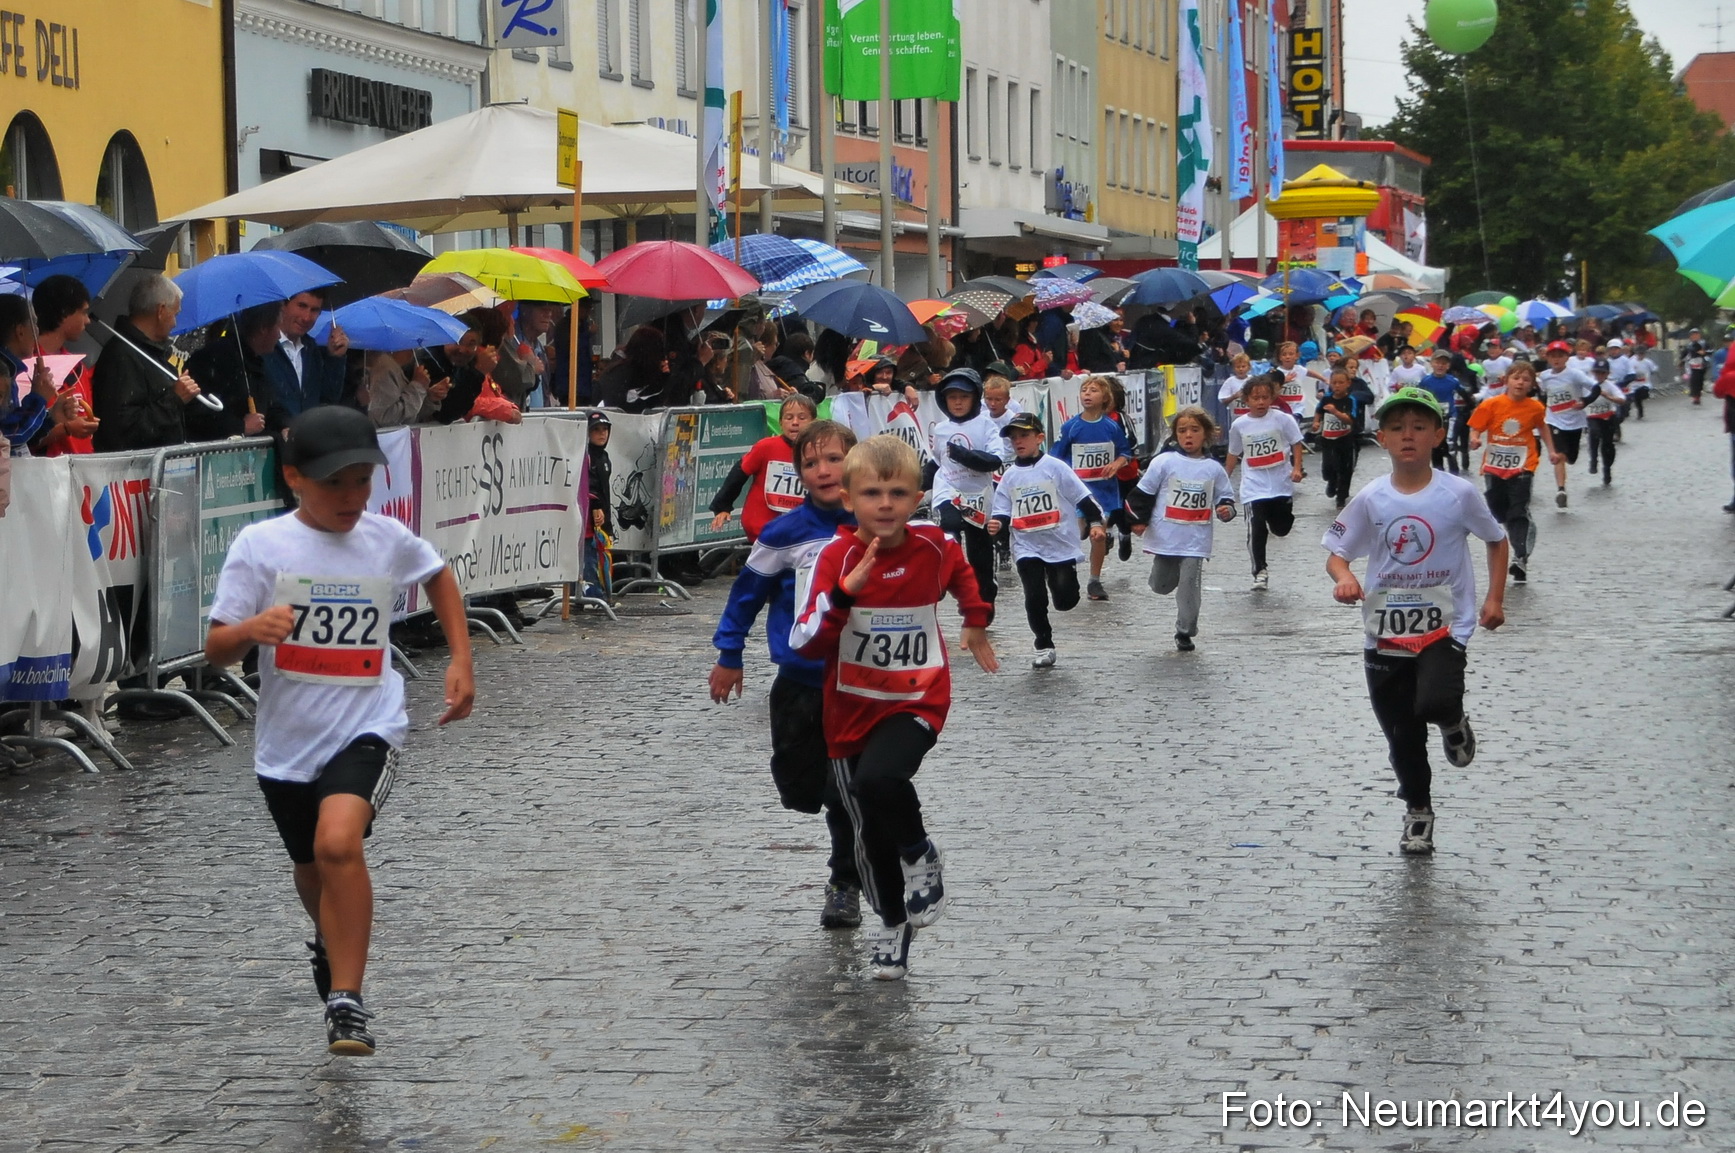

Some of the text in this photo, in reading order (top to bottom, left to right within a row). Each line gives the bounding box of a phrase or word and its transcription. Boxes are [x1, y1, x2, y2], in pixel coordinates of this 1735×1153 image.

[850, 31, 944, 43] Verantortung leben.
[0, 10, 79, 90] FE DELI
[862, 45, 933, 55] Gens schaffen.
[320, 69, 432, 133] BRILLEN WEBER
[1247, 439, 1278, 457] 7252
[1077, 452, 1110, 468] 7068
[1490, 453, 1520, 468] 7259
[436, 464, 477, 501] RECHTS
[510, 452, 571, 488] ANWÄLTE
[1016, 493, 1053, 518] 7120
[1172, 490, 1207, 508] 7298
[1376, 572, 1403, 580] AUFEN
[311, 584, 360, 596] BOCK
[289, 604, 379, 645] 7322
[871, 614, 914, 625] BOCK
[1375, 606, 1443, 636] 7028
[852, 630, 928, 668] 7340
[328, 991, 348, 999] ORT
